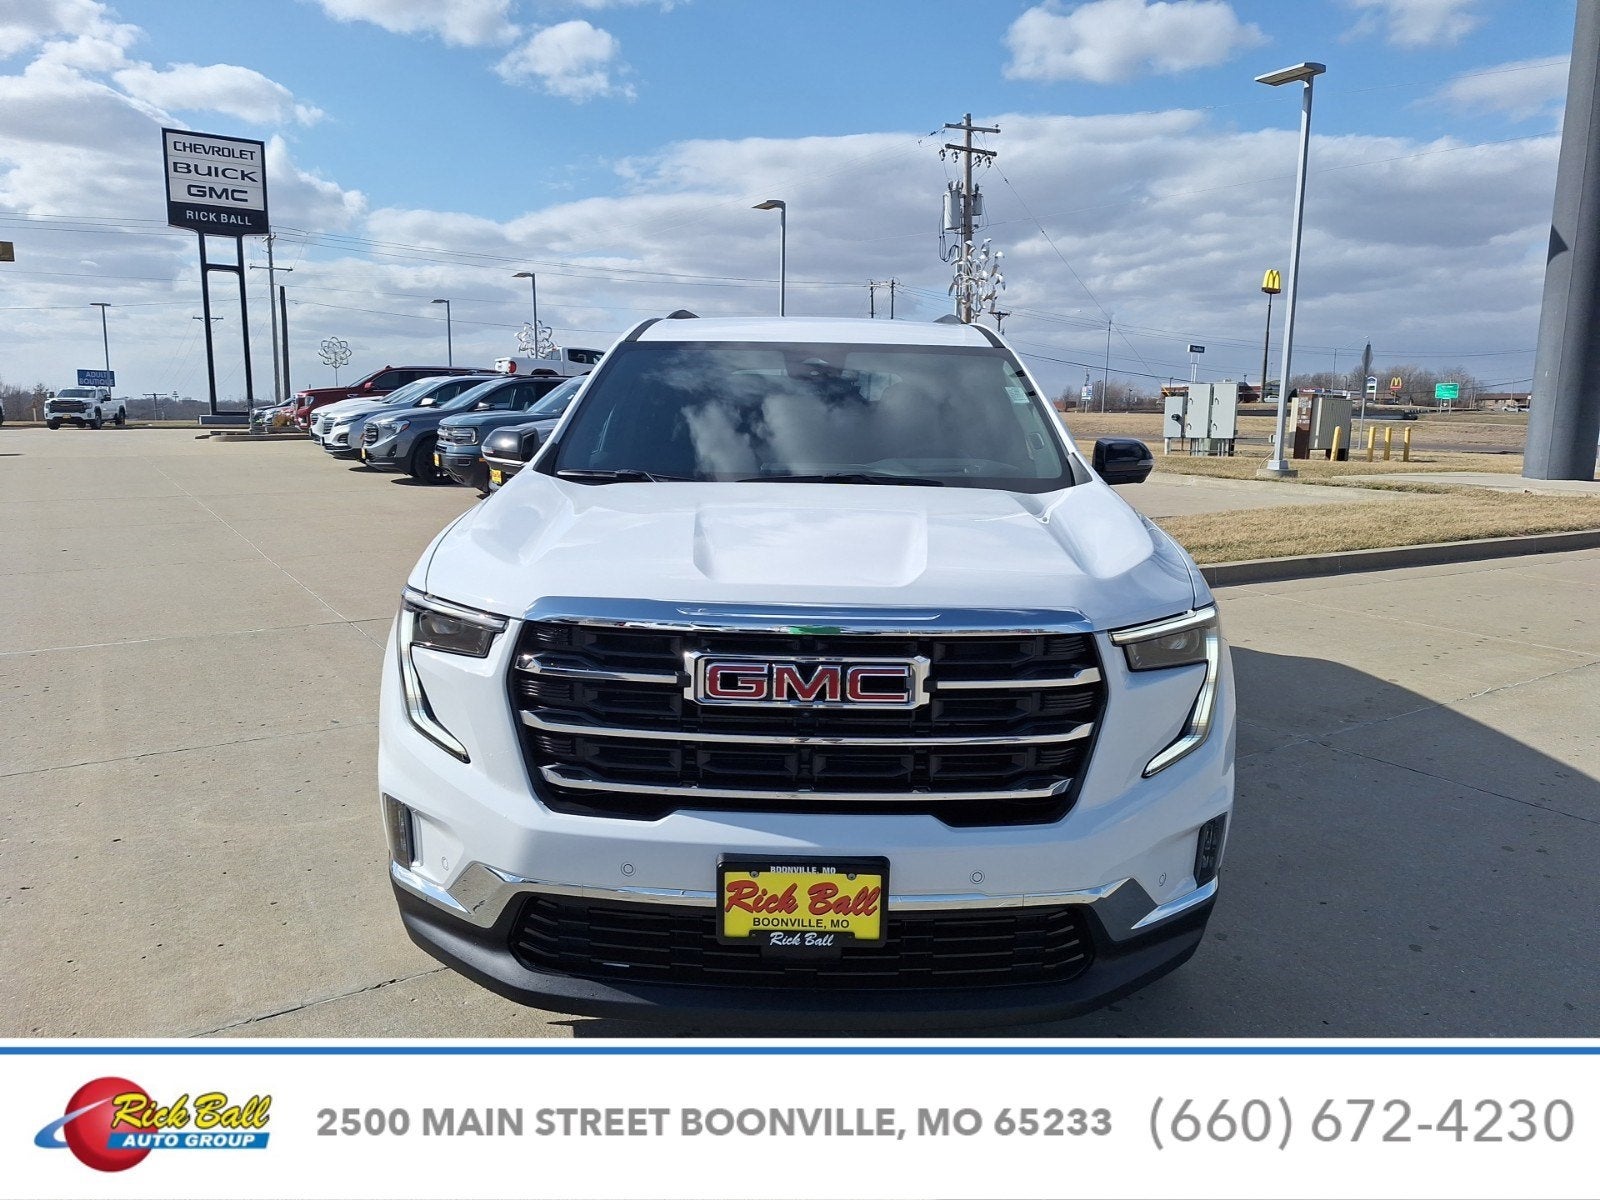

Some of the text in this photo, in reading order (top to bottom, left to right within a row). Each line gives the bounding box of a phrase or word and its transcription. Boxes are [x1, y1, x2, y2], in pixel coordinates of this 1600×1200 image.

[173, 140, 256, 161] CHEVROLET
[173, 161, 259, 183] BUICK
[187, 184, 248, 202] GMC
[186, 210, 252, 226] RICK BALL
[706, 662, 910, 702] GMC
[725, 879, 881, 917] Rick Ball
[752, 917, 850, 929] BOONVILLE, MO
[769, 931, 834, 947] Rick Ball
